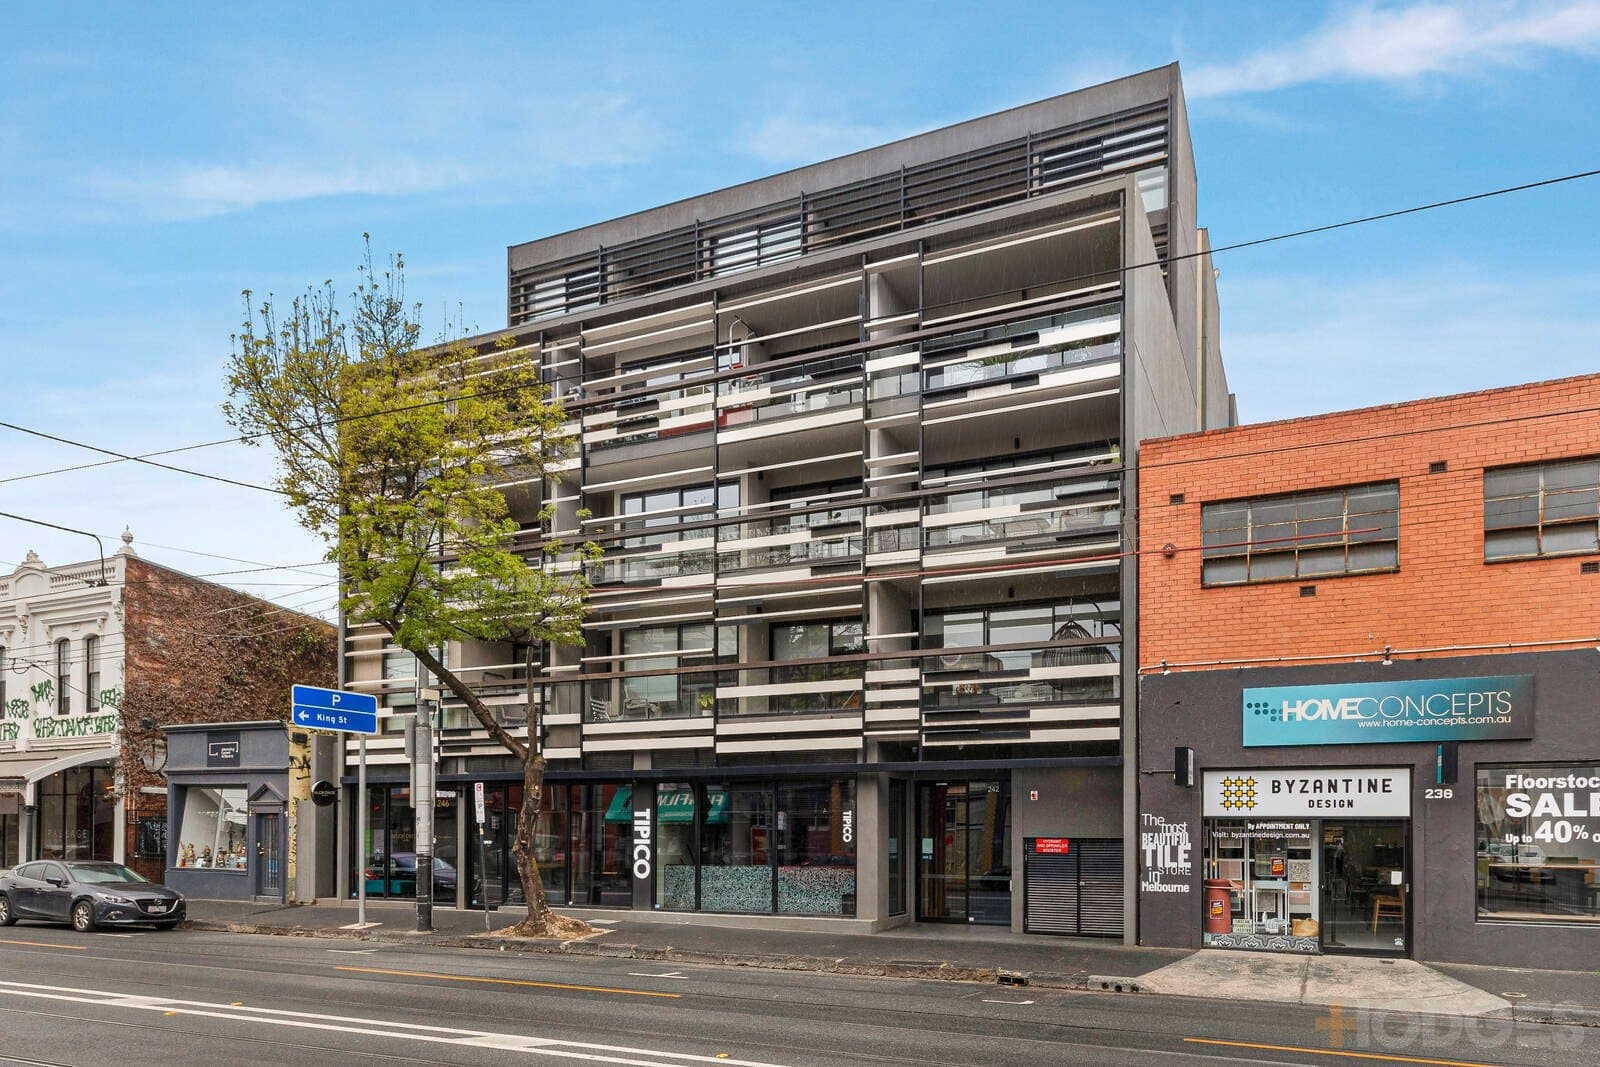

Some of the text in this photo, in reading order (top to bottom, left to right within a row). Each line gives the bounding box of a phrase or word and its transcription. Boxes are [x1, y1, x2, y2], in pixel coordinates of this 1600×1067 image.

[332, 695, 341, 706] P
[316, 713, 347, 725] King St
[1358, 715, 1512, 728] www.home-concepts.com.au
[1271, 778, 1393, 794] BYZANTINE
[1308, 799, 1354, 809] DESIGN
[842, 810, 852, 842] TIPICO
[1141, 813, 1165, 826] The
[1161, 822, 1188, 834] most
[1247, 823, 1255, 831] By
[1505, 834, 1519, 845] Up
[1521, 834, 1533, 843] to
[1534, 820, 1589, 843] 40%
[1142, 833, 1189, 846] BEAUTIFUL
[1231, 831, 1310, 840] byzantinedesign.com.au
[633, 808, 651, 879] TIPICO
[1141, 843, 1192, 868] TILE
[1148, 867, 1161, 883] in
[1159, 866, 1192, 876] STORE
[1141, 881, 1190, 893] Melbourne
